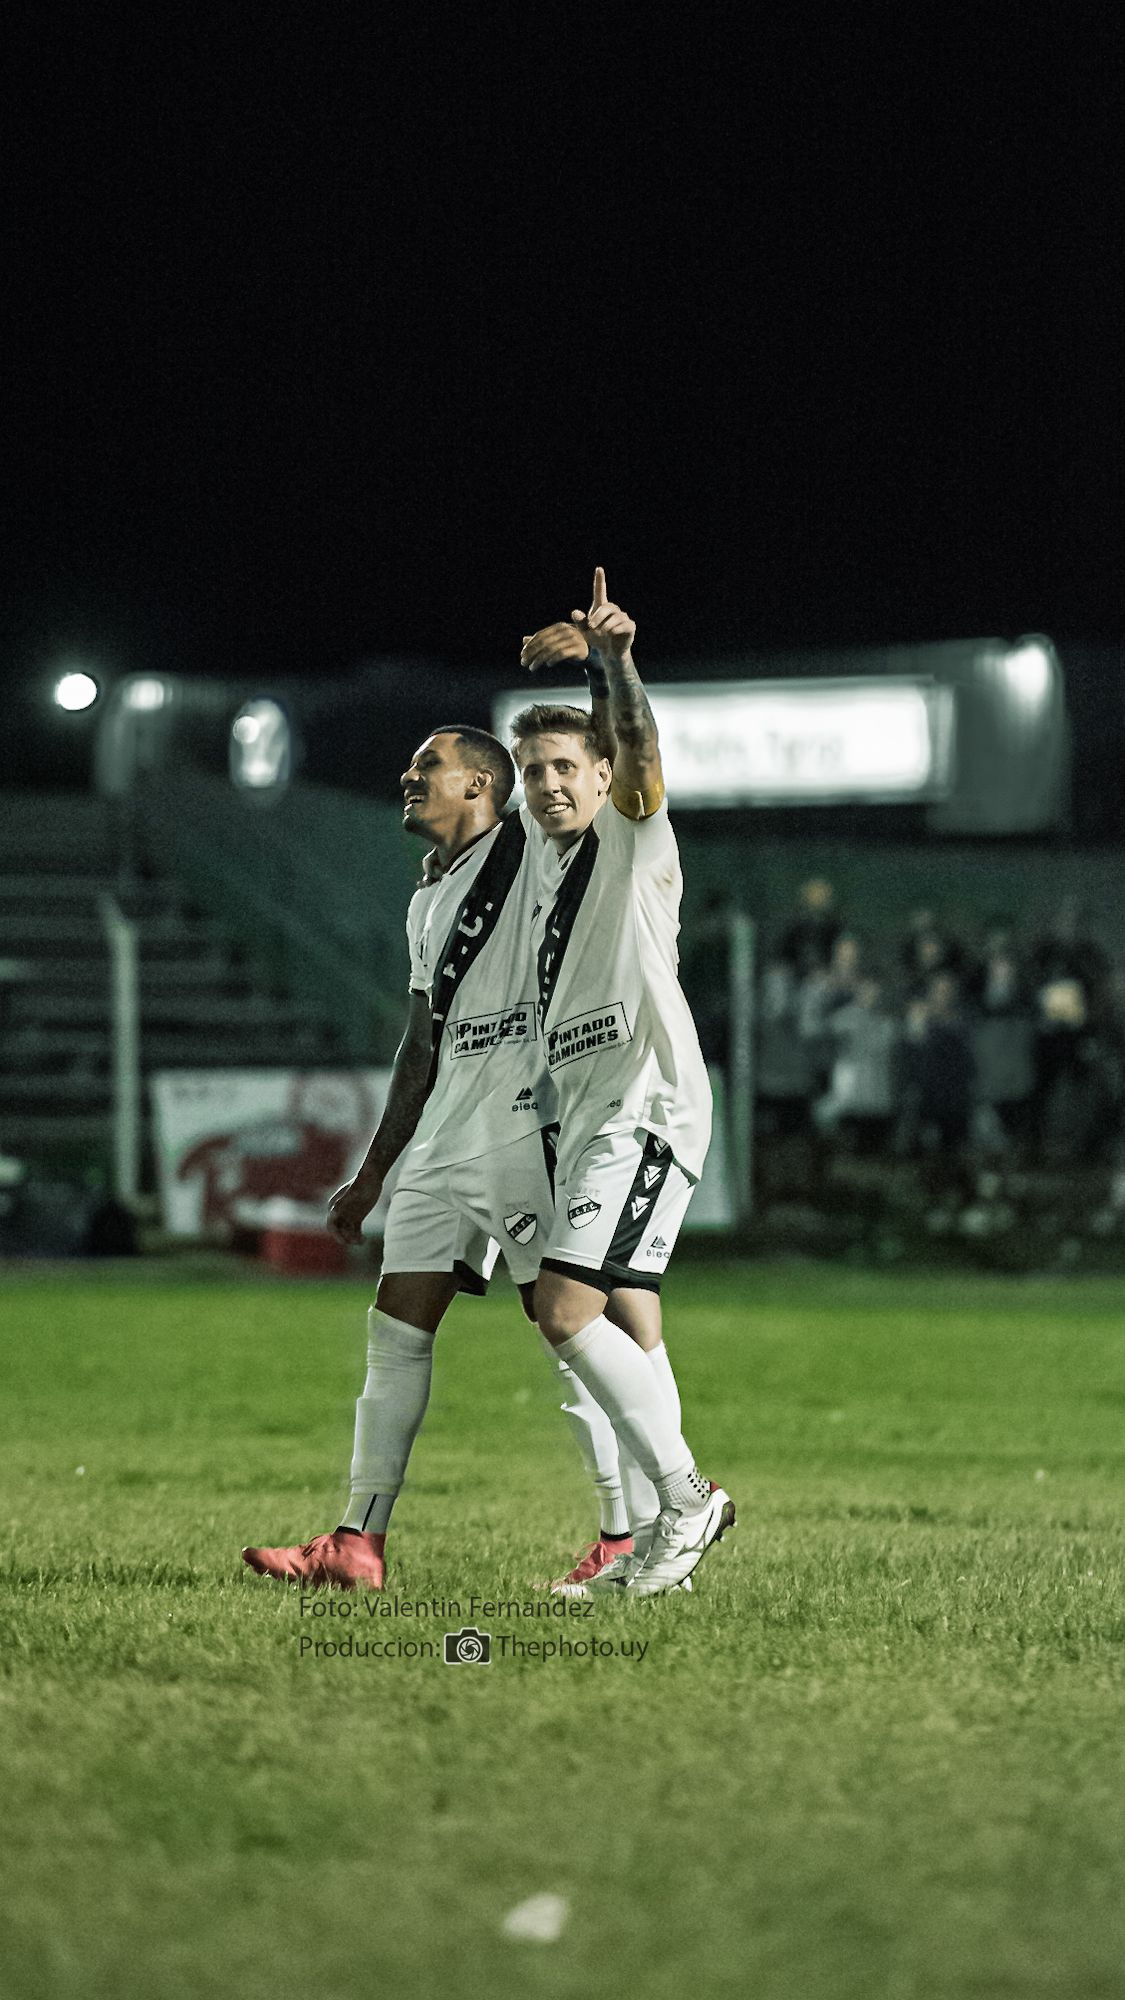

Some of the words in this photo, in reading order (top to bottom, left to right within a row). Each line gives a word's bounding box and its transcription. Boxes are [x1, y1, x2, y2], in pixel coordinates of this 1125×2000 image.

[454, 1025, 527, 1054] CAMIOES
[547, 1015, 616, 1051] PINTADO
[548, 1029, 619, 1066] CAMIONES
